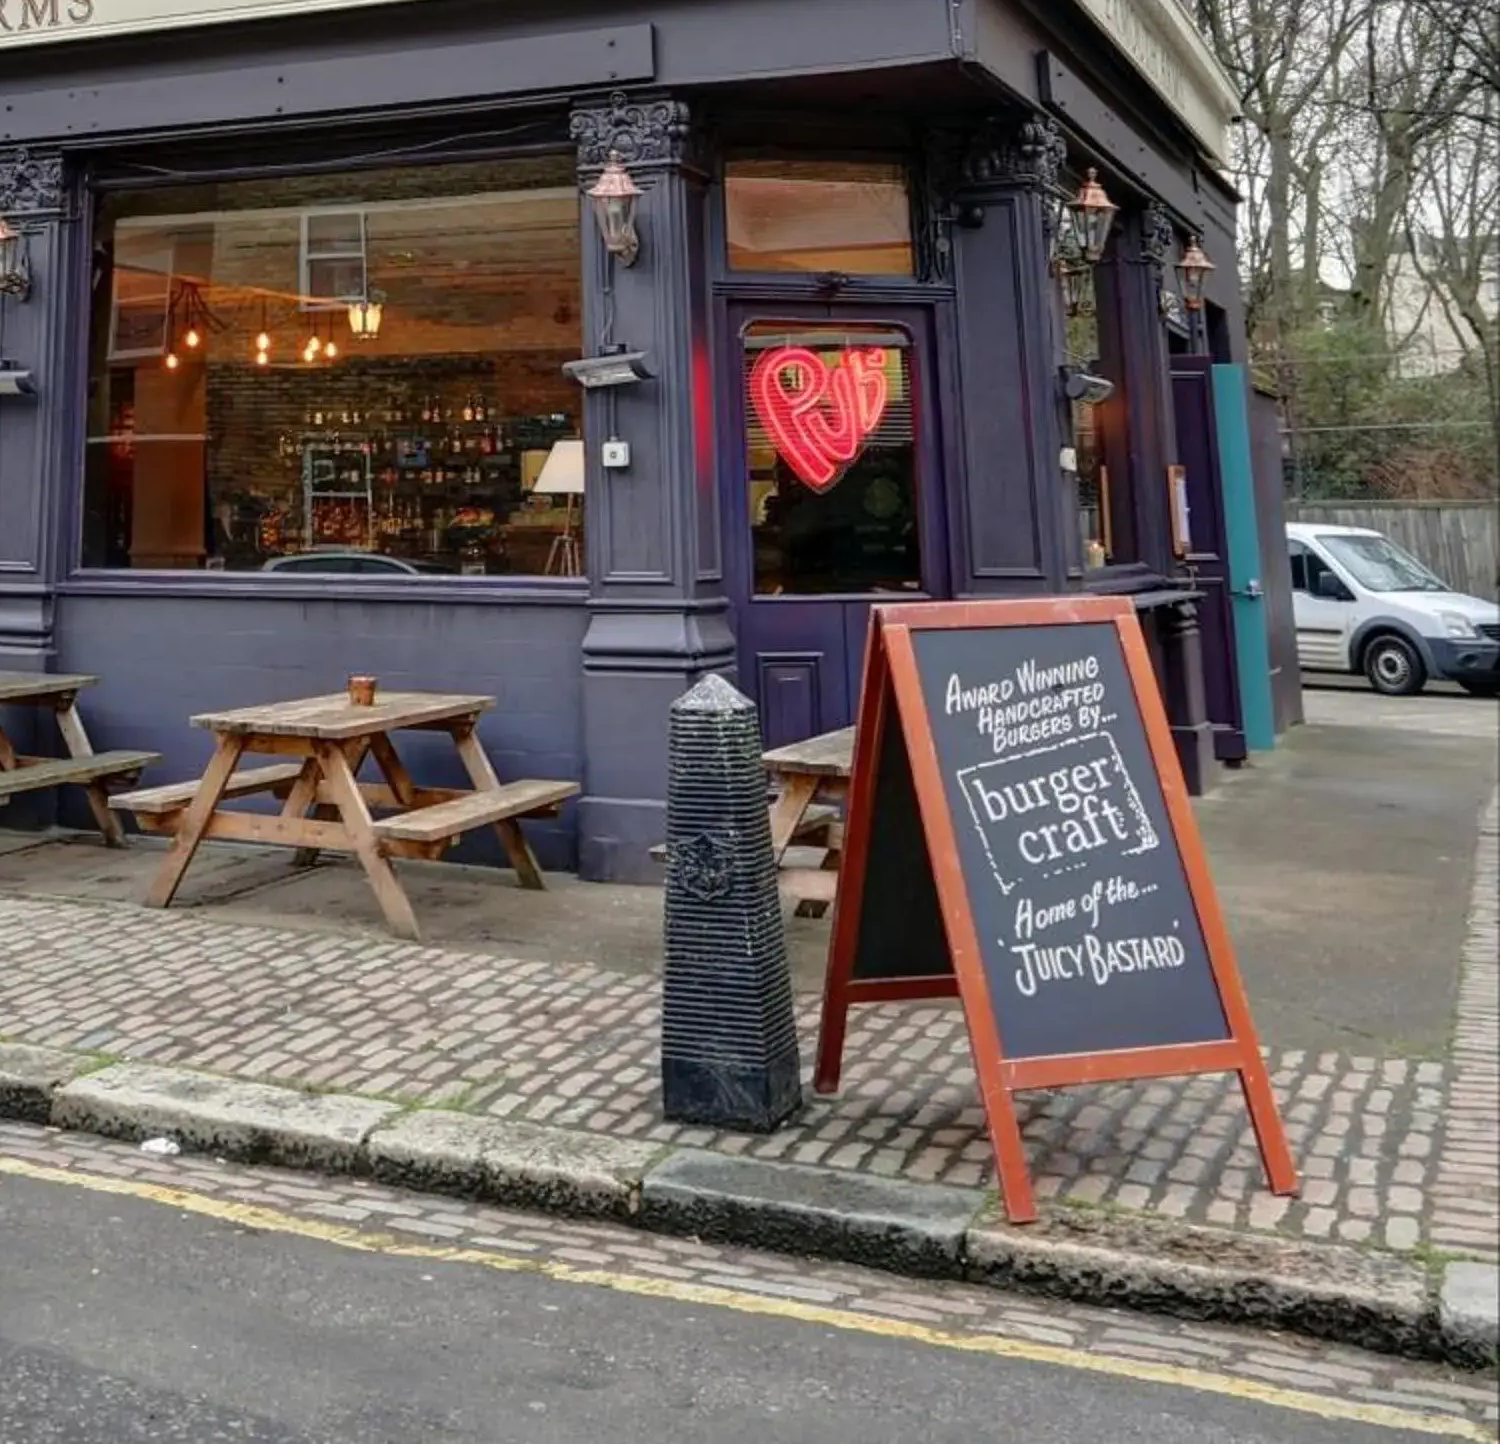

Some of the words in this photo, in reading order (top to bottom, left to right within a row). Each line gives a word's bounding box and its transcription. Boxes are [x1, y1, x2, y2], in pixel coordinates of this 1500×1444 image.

[944, 672, 1014, 715] AWARD
[1015, 656, 1100, 695] WINNING
[977, 682, 1105, 736] HANDCRAFTED
[992, 715, 1073, 753] BURGERS
[974, 756, 1113, 822] burger
[1017, 796, 1129, 865] craft
[1013, 898, 1076, 940] Home
[1080, 880, 1103, 929] of
